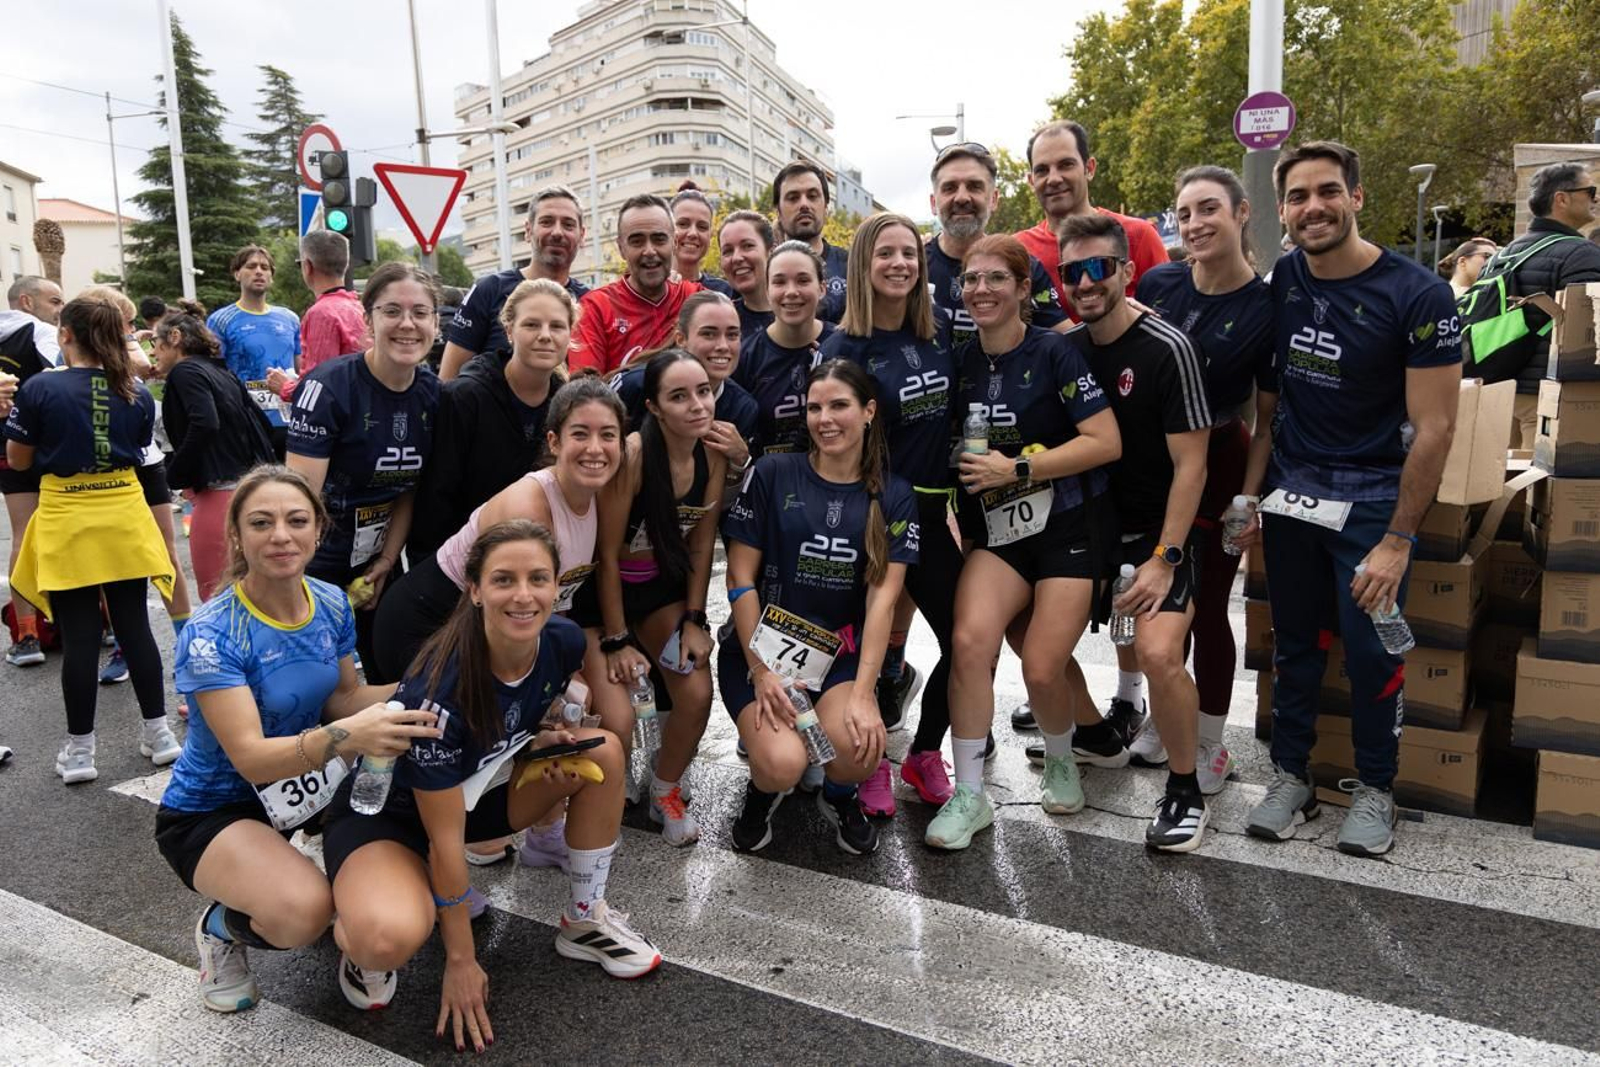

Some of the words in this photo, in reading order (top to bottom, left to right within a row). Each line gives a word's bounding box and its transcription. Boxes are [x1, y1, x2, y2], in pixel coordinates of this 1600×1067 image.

[1289, 326, 1342, 361] 25
[899, 369, 949, 401] 25
[775, 393, 807, 418] 2
[375, 446, 423, 471] 25
[1002, 500, 1034, 528] 70
[800, 534, 858, 563] 25
[766, 608, 787, 624] XXV
[777, 637, 809, 670] 74
